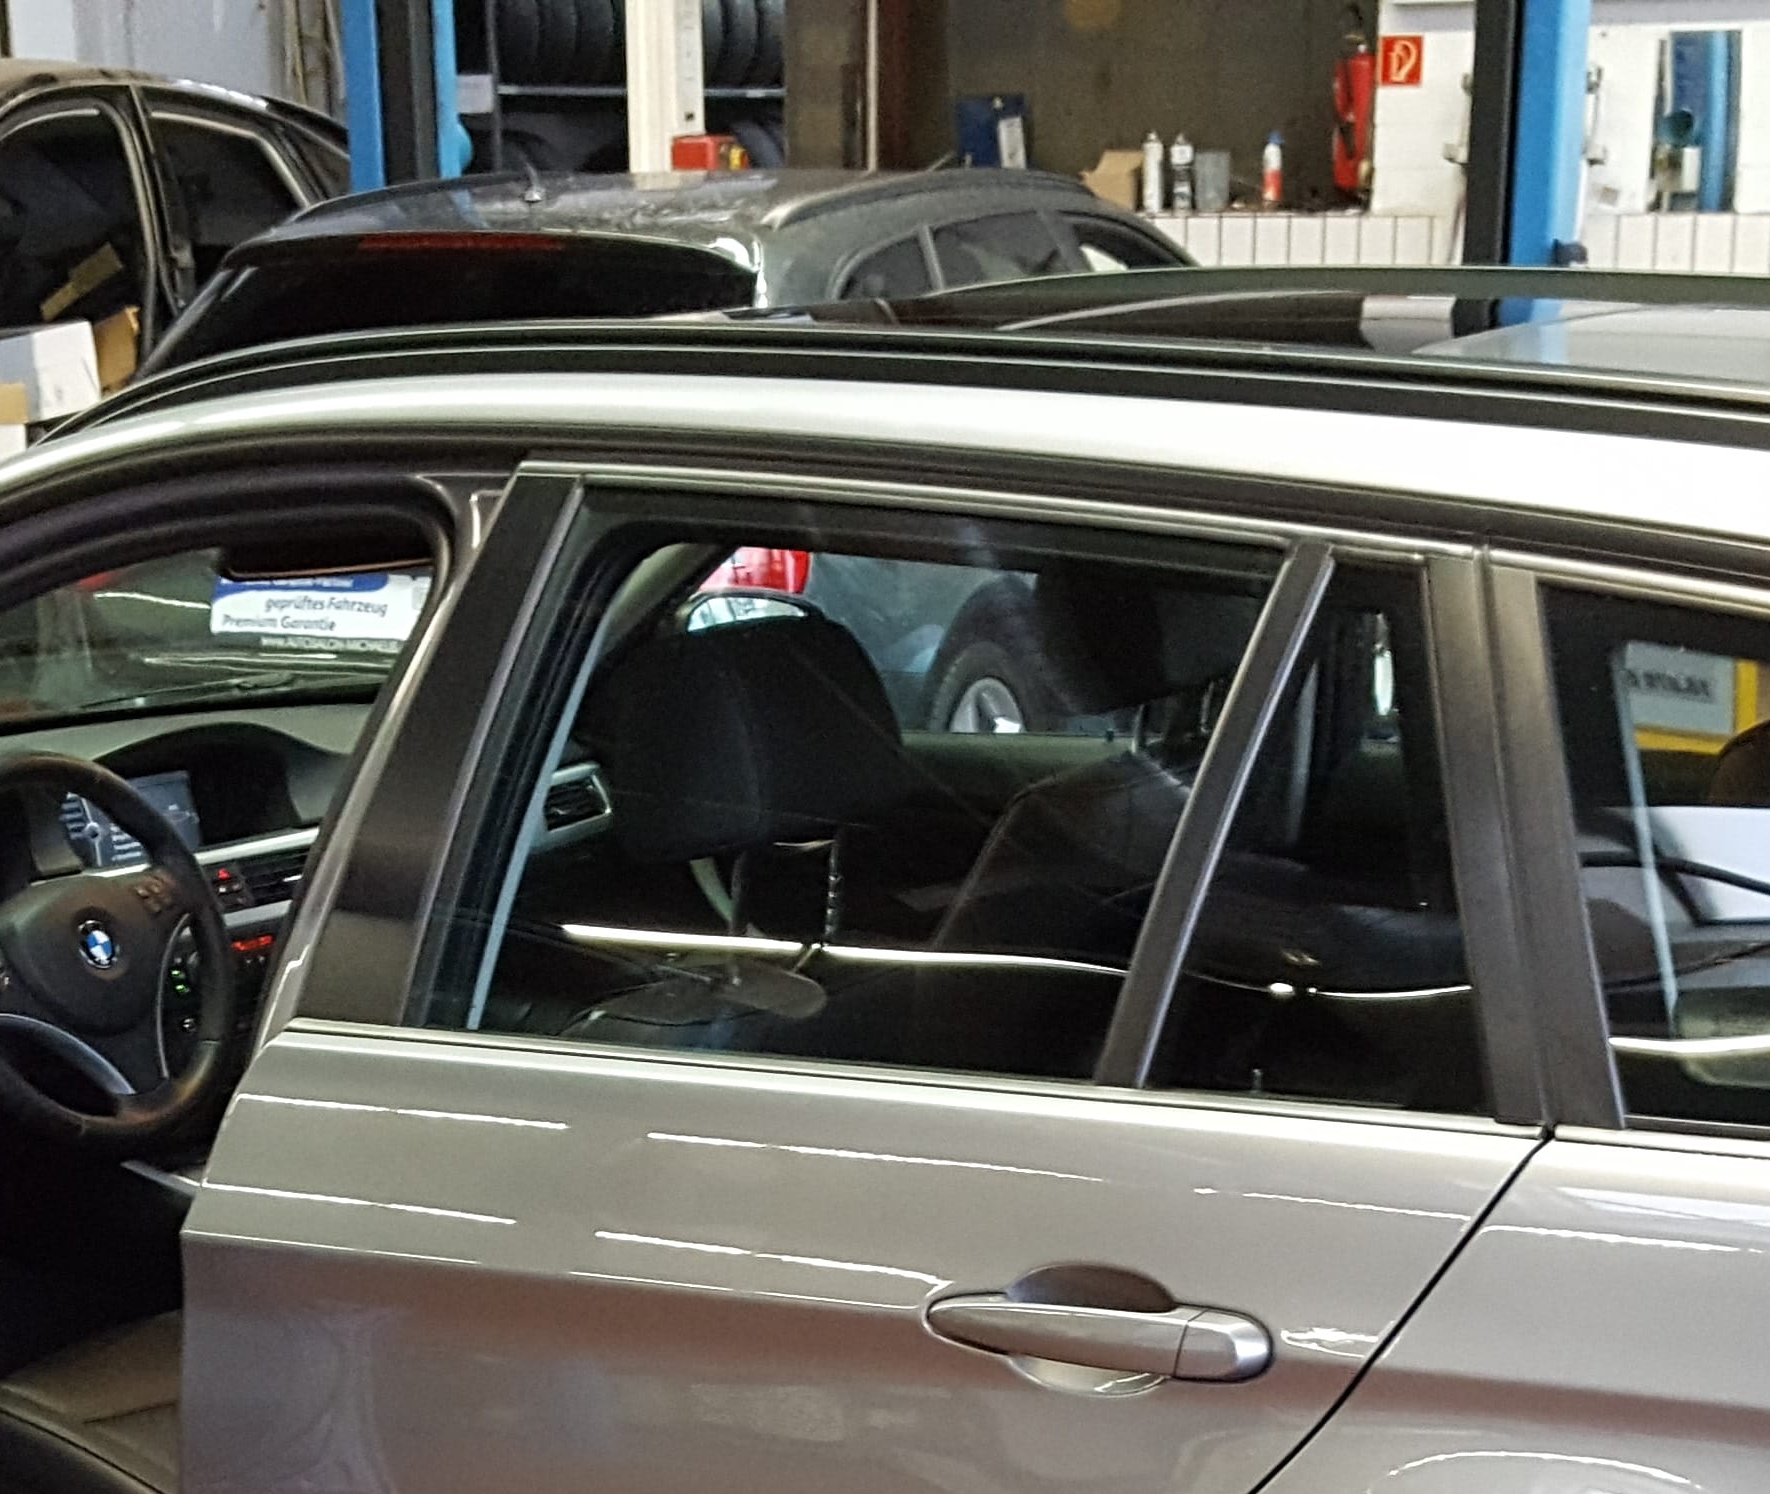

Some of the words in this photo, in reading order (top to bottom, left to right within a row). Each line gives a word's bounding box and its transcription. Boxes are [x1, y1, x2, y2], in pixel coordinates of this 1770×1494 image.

[327, 596, 388, 618] Fahrzeug
[222, 613, 278, 629] Premium
[280, 615, 337, 632] Garantie
